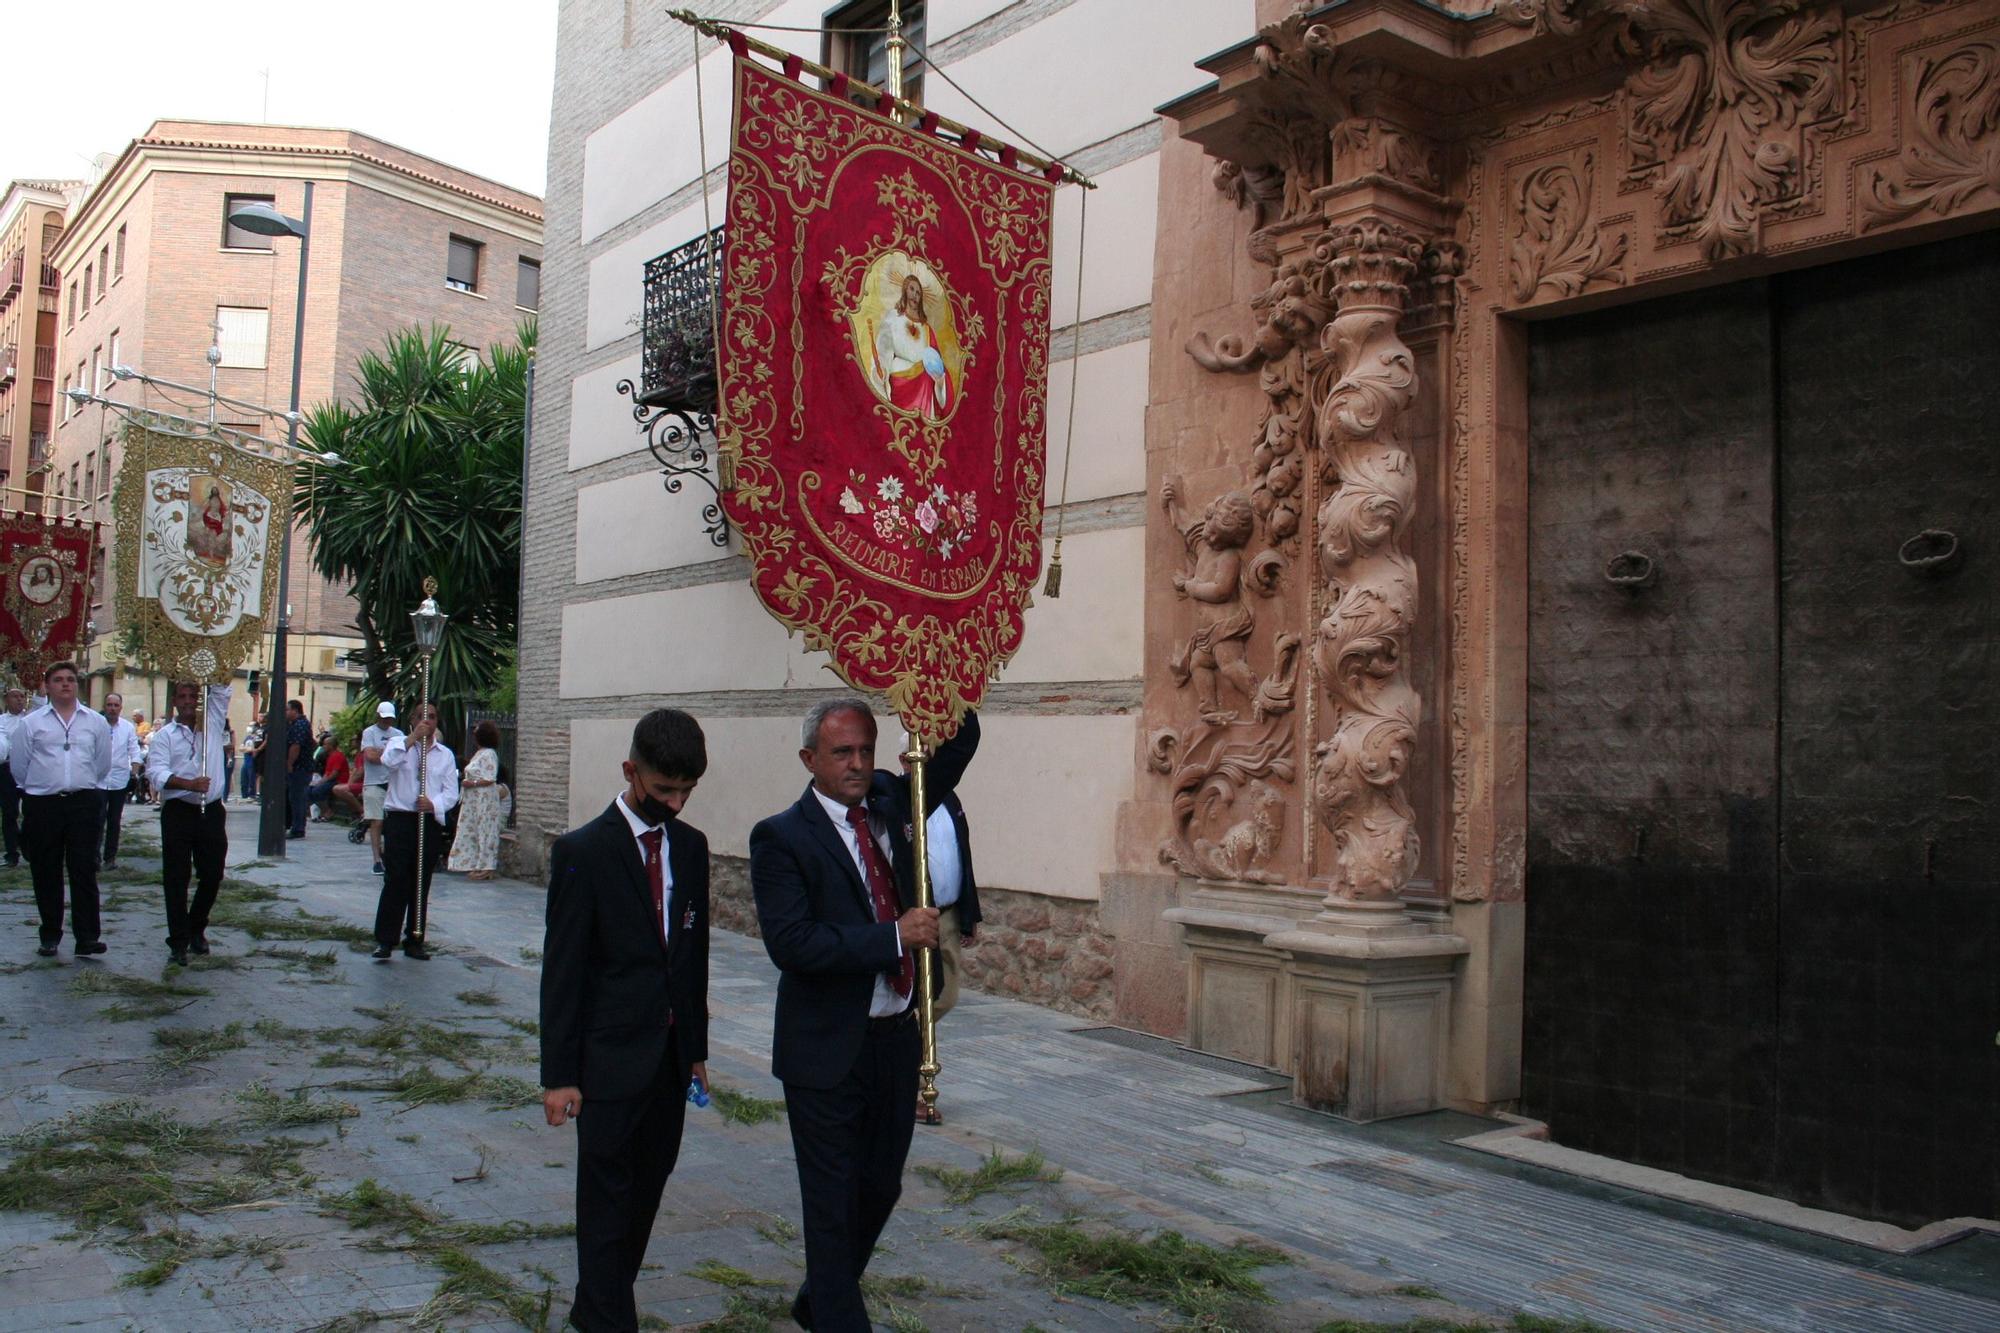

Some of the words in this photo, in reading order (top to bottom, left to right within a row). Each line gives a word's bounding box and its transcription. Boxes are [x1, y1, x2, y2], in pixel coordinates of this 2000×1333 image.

[827, 521, 914, 581] REINARE
[921, 568, 937, 588] EN
[942, 556, 987, 591] ESPAÑA
